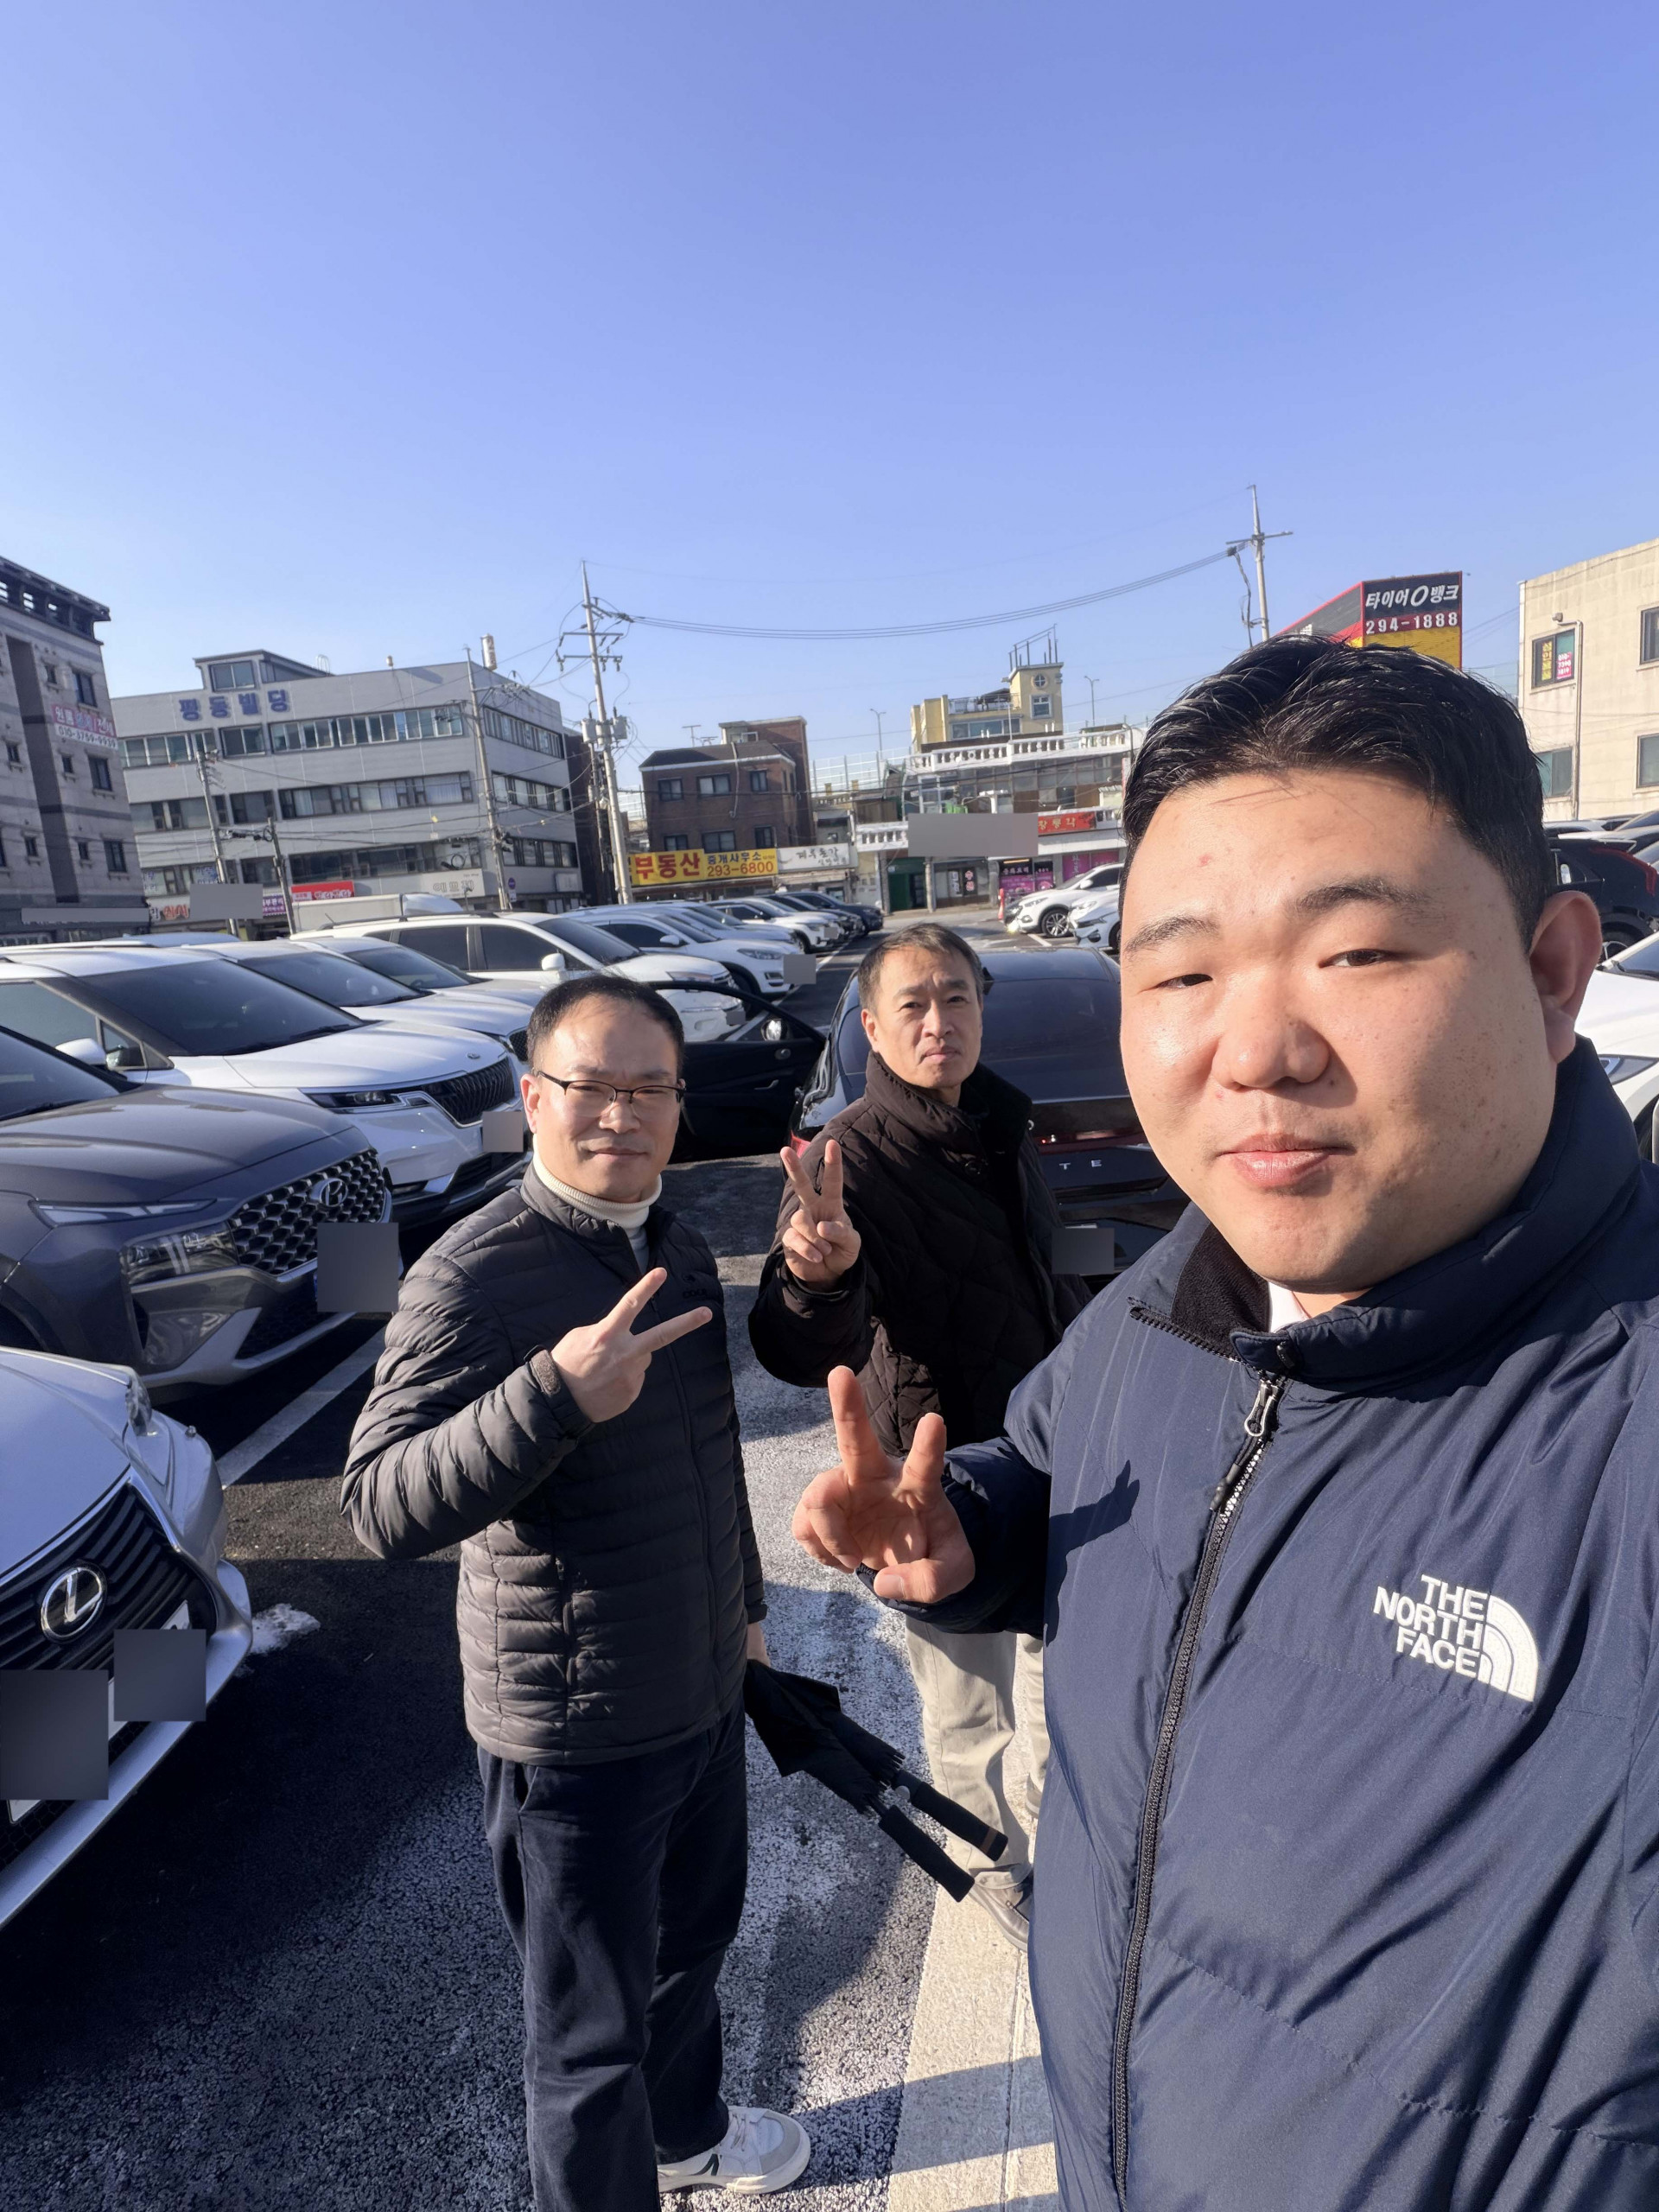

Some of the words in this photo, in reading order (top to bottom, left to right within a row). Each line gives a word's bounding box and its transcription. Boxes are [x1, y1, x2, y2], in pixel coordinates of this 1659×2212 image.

[1365, 612, 1458, 635] 294-1888
[635, 852, 701, 880] 부동산
[707, 851, 761, 865] 중개사무소
[707, 861, 774, 877] 293-6800
[1421, 1573, 1489, 1622] THE
[1373, 1586, 1484, 1650] NORTH
[1395, 1626, 1480, 1679] FACE
